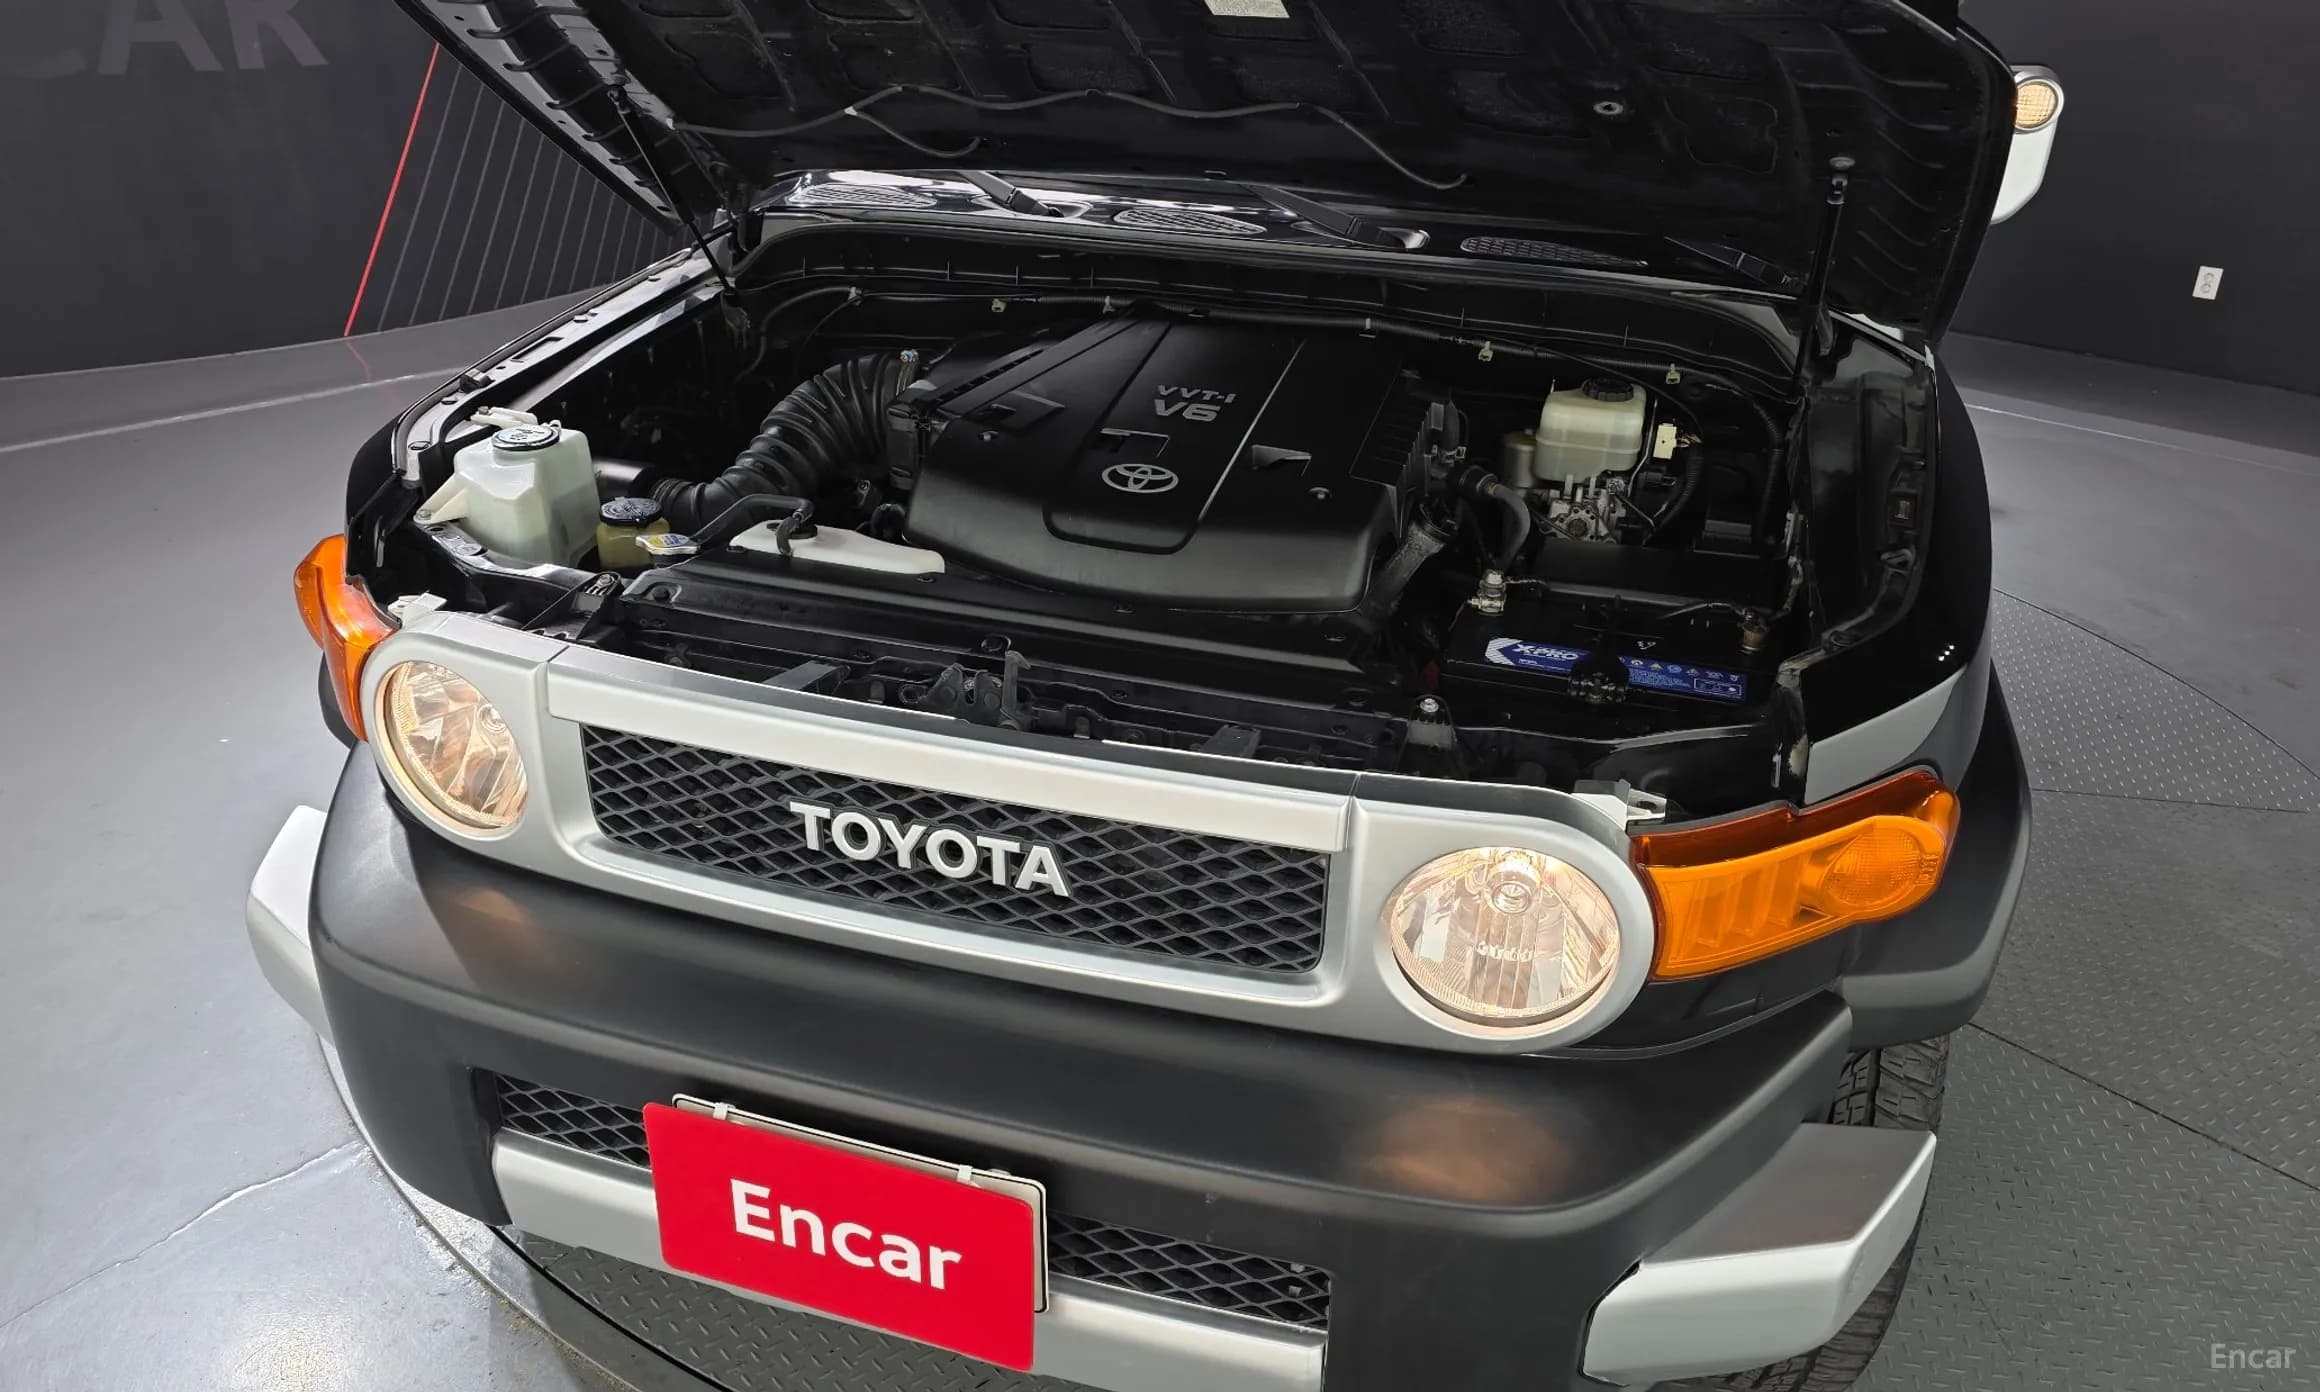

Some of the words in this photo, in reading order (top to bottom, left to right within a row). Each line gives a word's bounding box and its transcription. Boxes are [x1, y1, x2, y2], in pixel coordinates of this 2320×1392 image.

[0, 0, 330, 78] AR
[1154, 398, 1221, 422] V6
[789, 800, 1071, 898] TOYOTA
[729, 1177, 964, 1291] Encar
